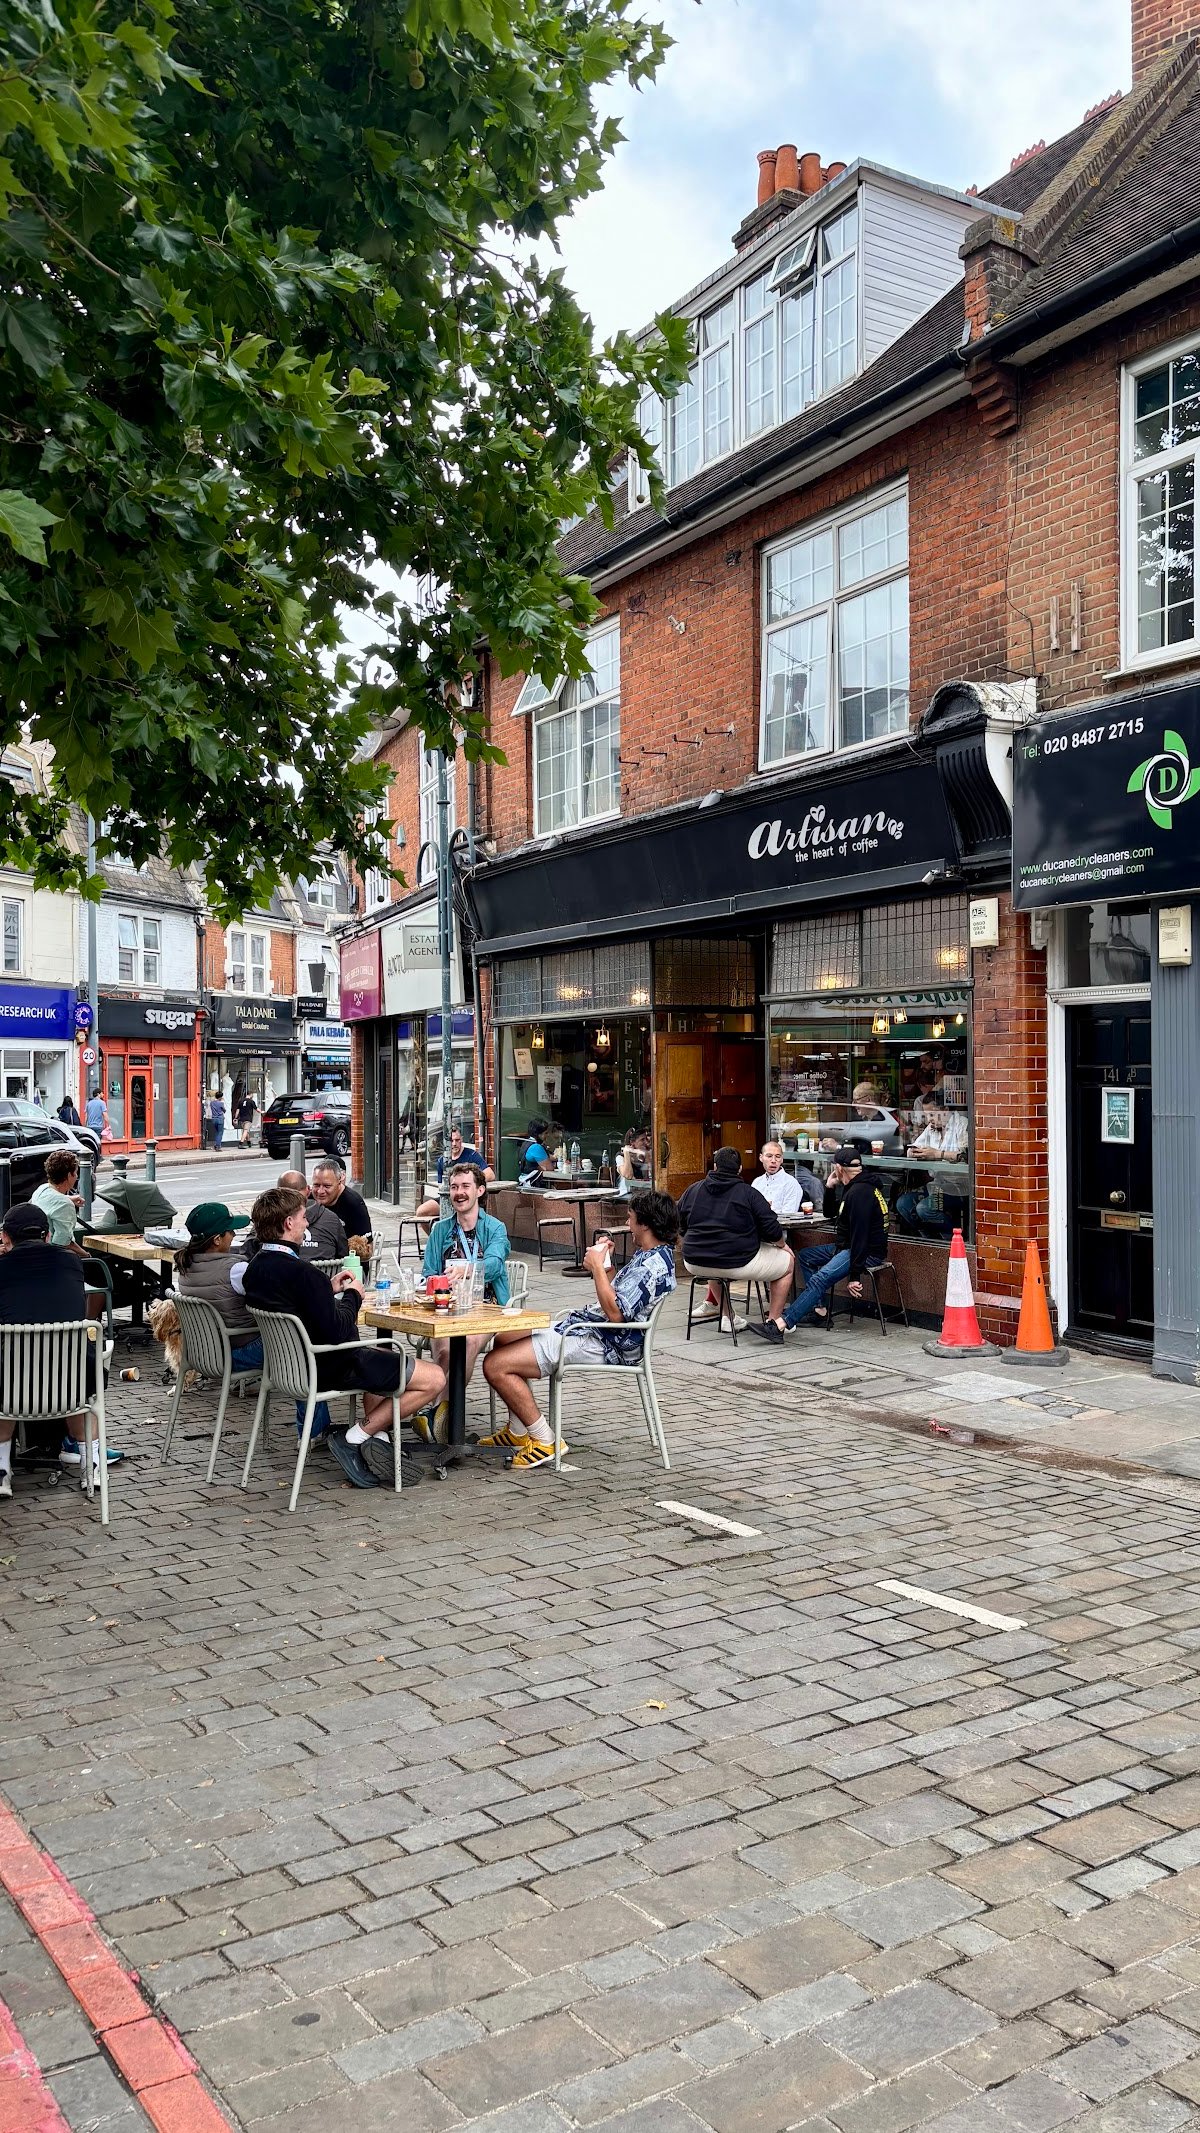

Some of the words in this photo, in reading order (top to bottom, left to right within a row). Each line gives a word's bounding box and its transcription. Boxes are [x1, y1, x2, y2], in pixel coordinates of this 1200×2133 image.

[1021, 744, 1041, 760] Tel:
[1043, 736, 1068, 756] 020
[1071, 726, 1105, 749] 8487
[1108, 716, 1145, 740] 2715
[1157, 766, 1179, 795] D
[795, 851, 809, 863] the
[812, 846, 834, 860] heart
[838, 842, 848, 857] of
[851, 837, 879, 854] coffee
[1020, 846, 1154, 875] www.ducanedrycleaners.com
[1020, 863, 1145, 889] ducanedrycleaners@gmail.com
[0, 1006, 43, 1019] RESEARCH
[45, 1008, 57, 1019] UK
[144, 1009, 196, 1030] sugar
[234, 1005, 253, 1018] TALA
[253, 1007, 277, 1019] DANIEL
[83, 1052, 94, 1060] 20
[1103, 1068, 1120, 1082] 141
